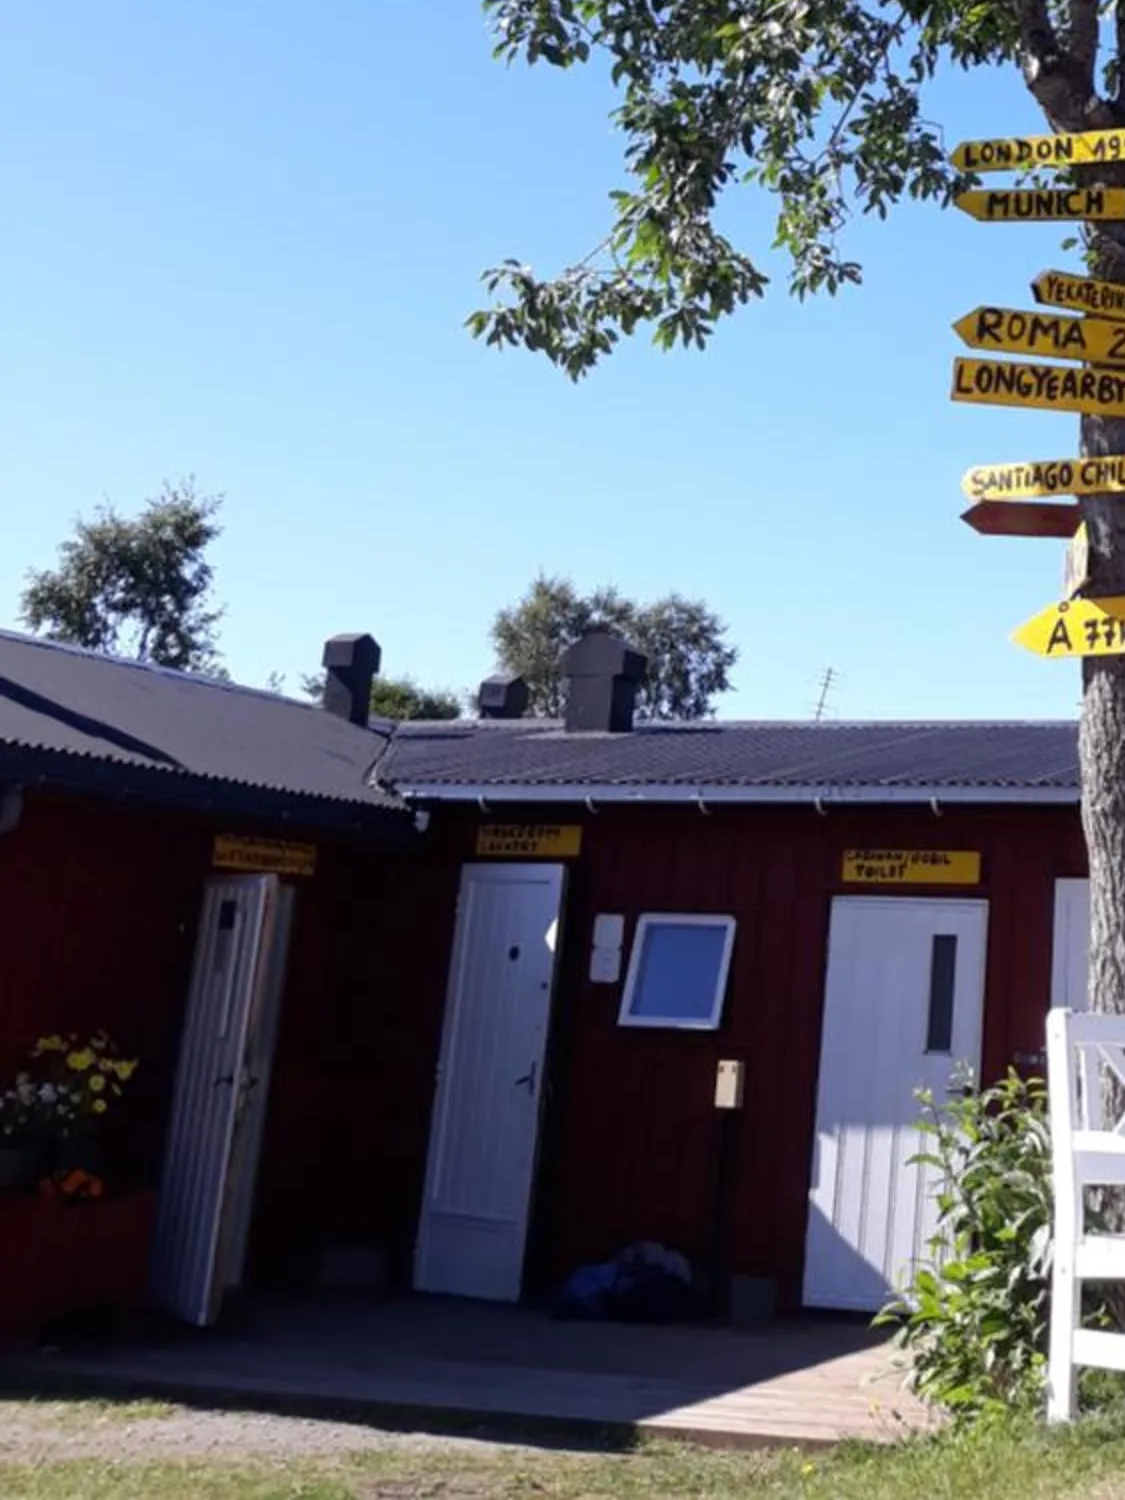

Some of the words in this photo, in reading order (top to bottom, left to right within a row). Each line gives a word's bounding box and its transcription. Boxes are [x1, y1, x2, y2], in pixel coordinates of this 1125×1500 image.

[963, 137, 1073, 168] LONDON
[986, 189, 1105, 218] MUNICH
[976, 309, 1087, 349] ROMA
[971, 461, 1073, 495] SANTIAGO
[1046, 601, 1072, 654] Å
[1083, 619, 1117, 646] 77
